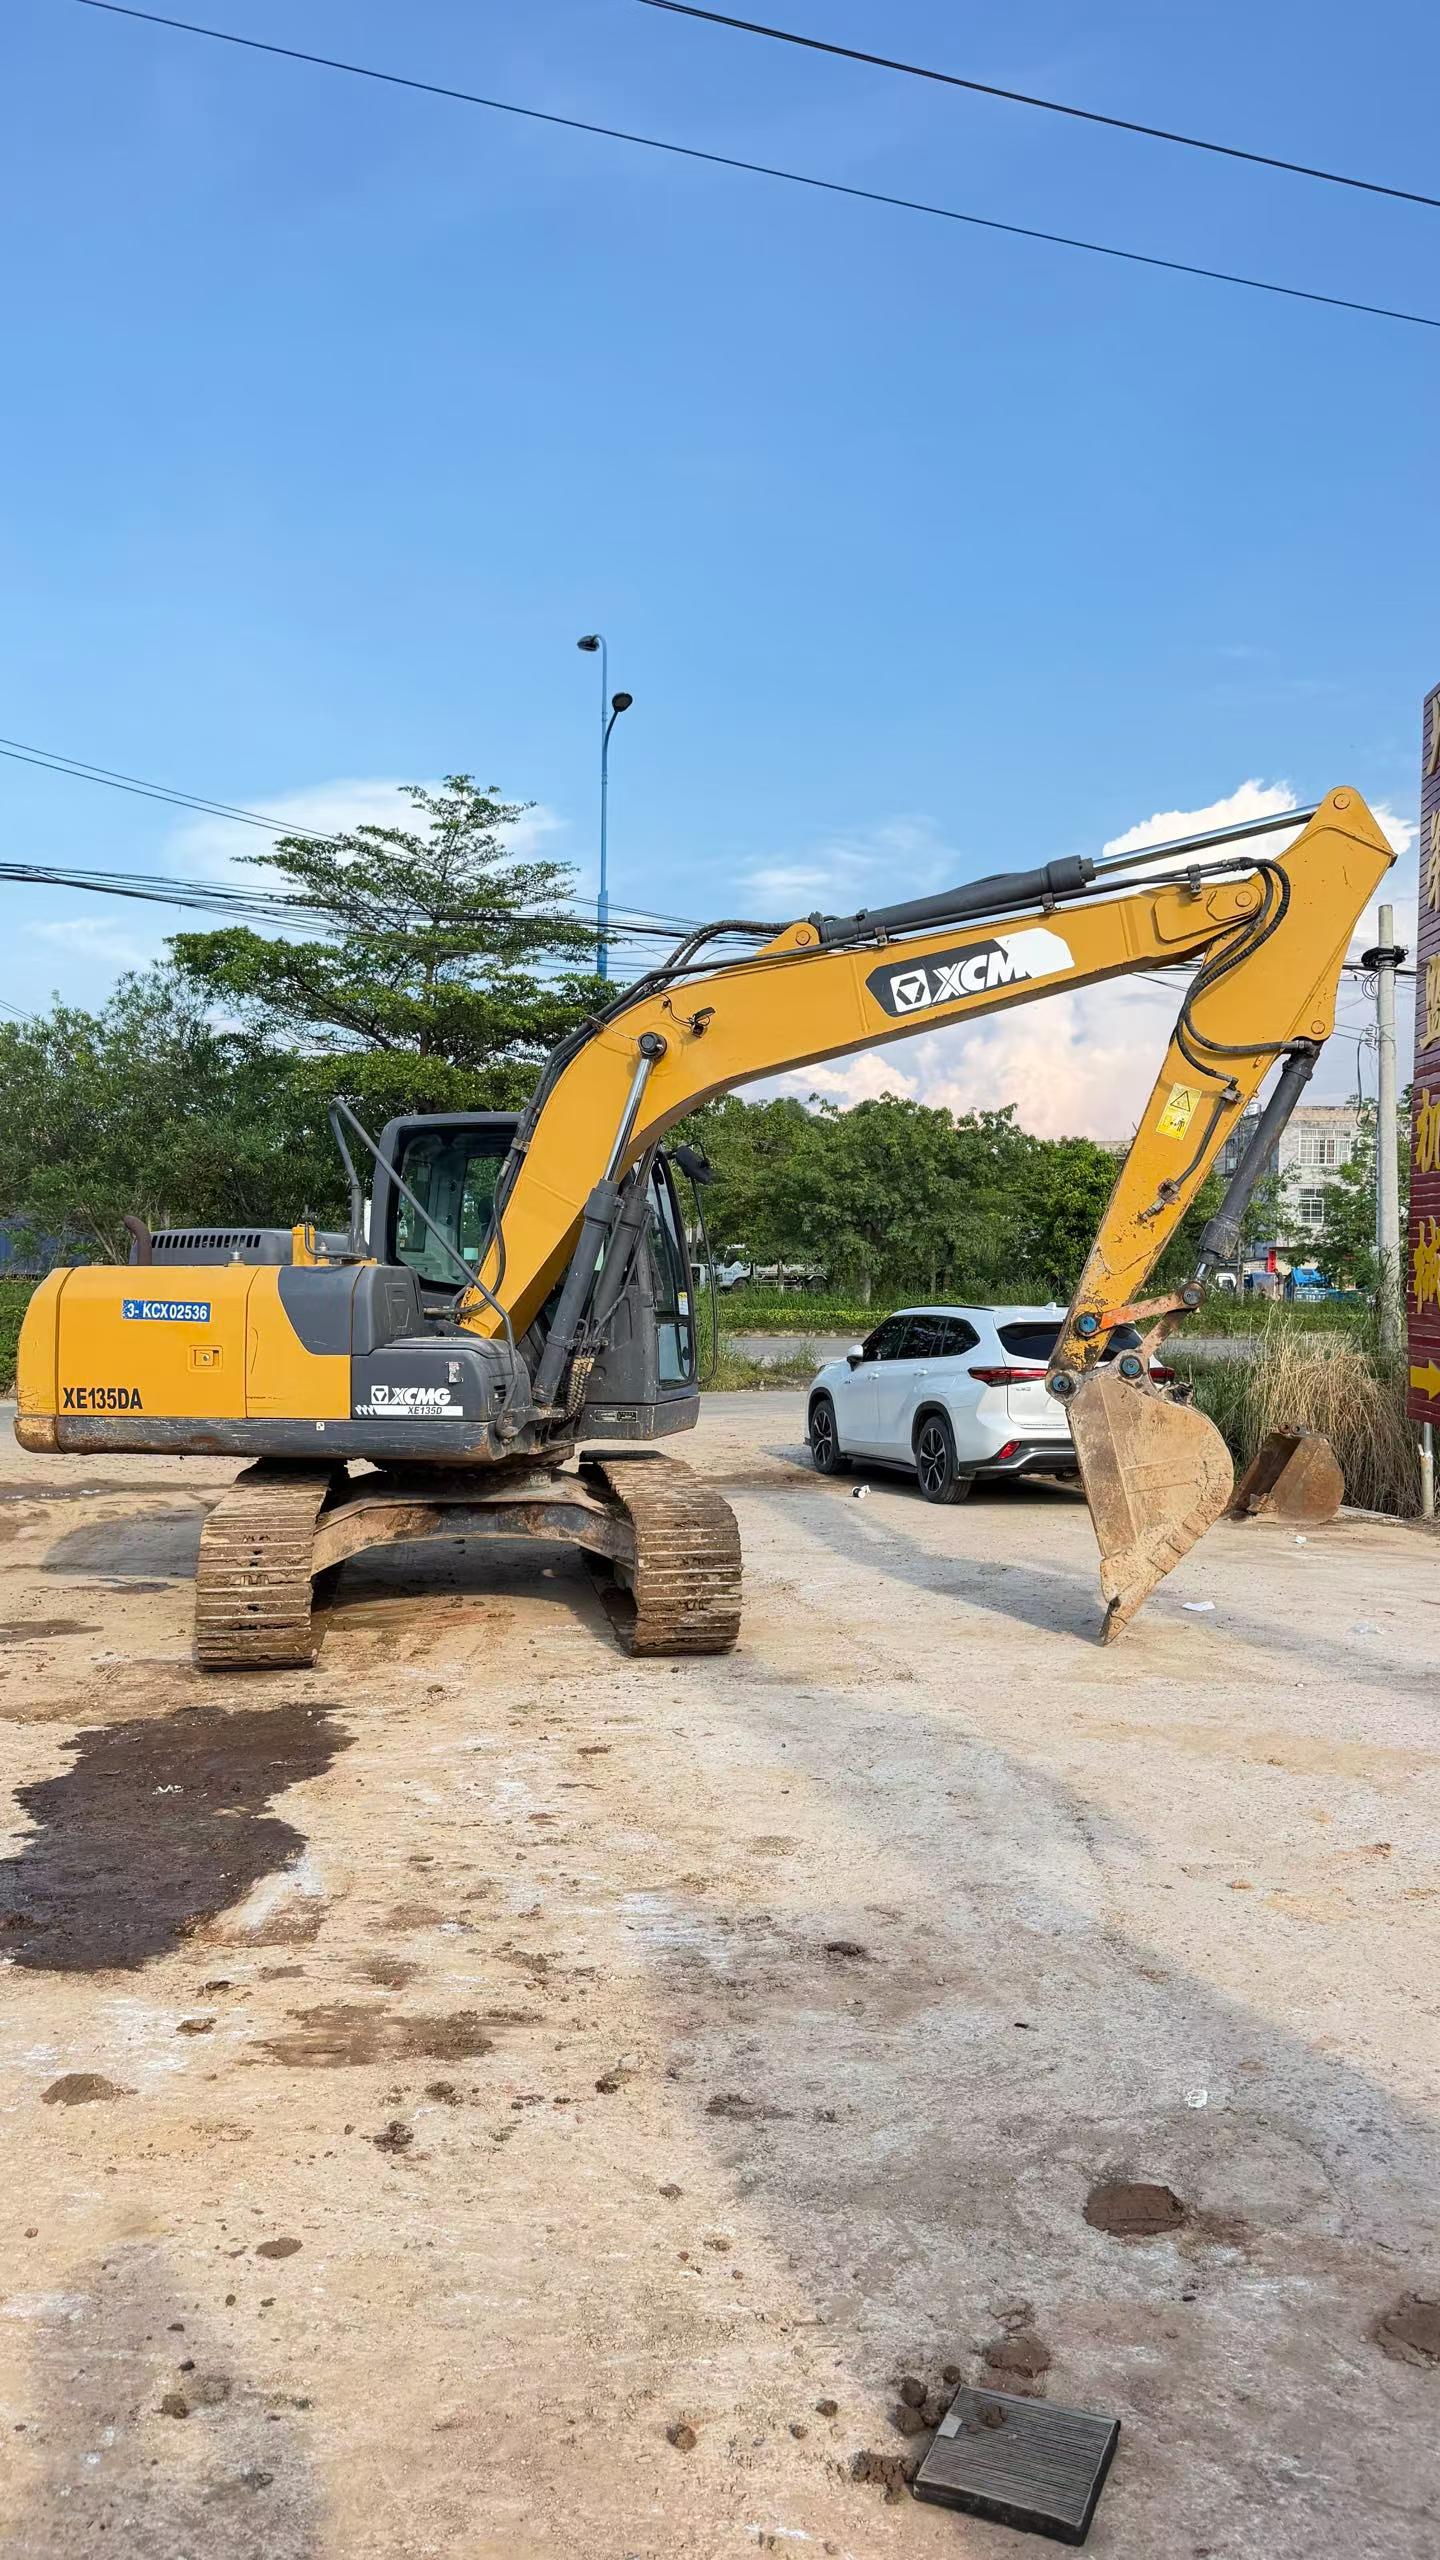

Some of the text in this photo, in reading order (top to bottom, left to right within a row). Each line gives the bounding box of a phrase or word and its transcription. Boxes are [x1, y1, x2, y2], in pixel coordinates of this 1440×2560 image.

[63, 1387, 143, 1409] XE135DA
[389, 1387, 451, 1406] XCMG
[408, 1406, 443, 1415] XE135D
